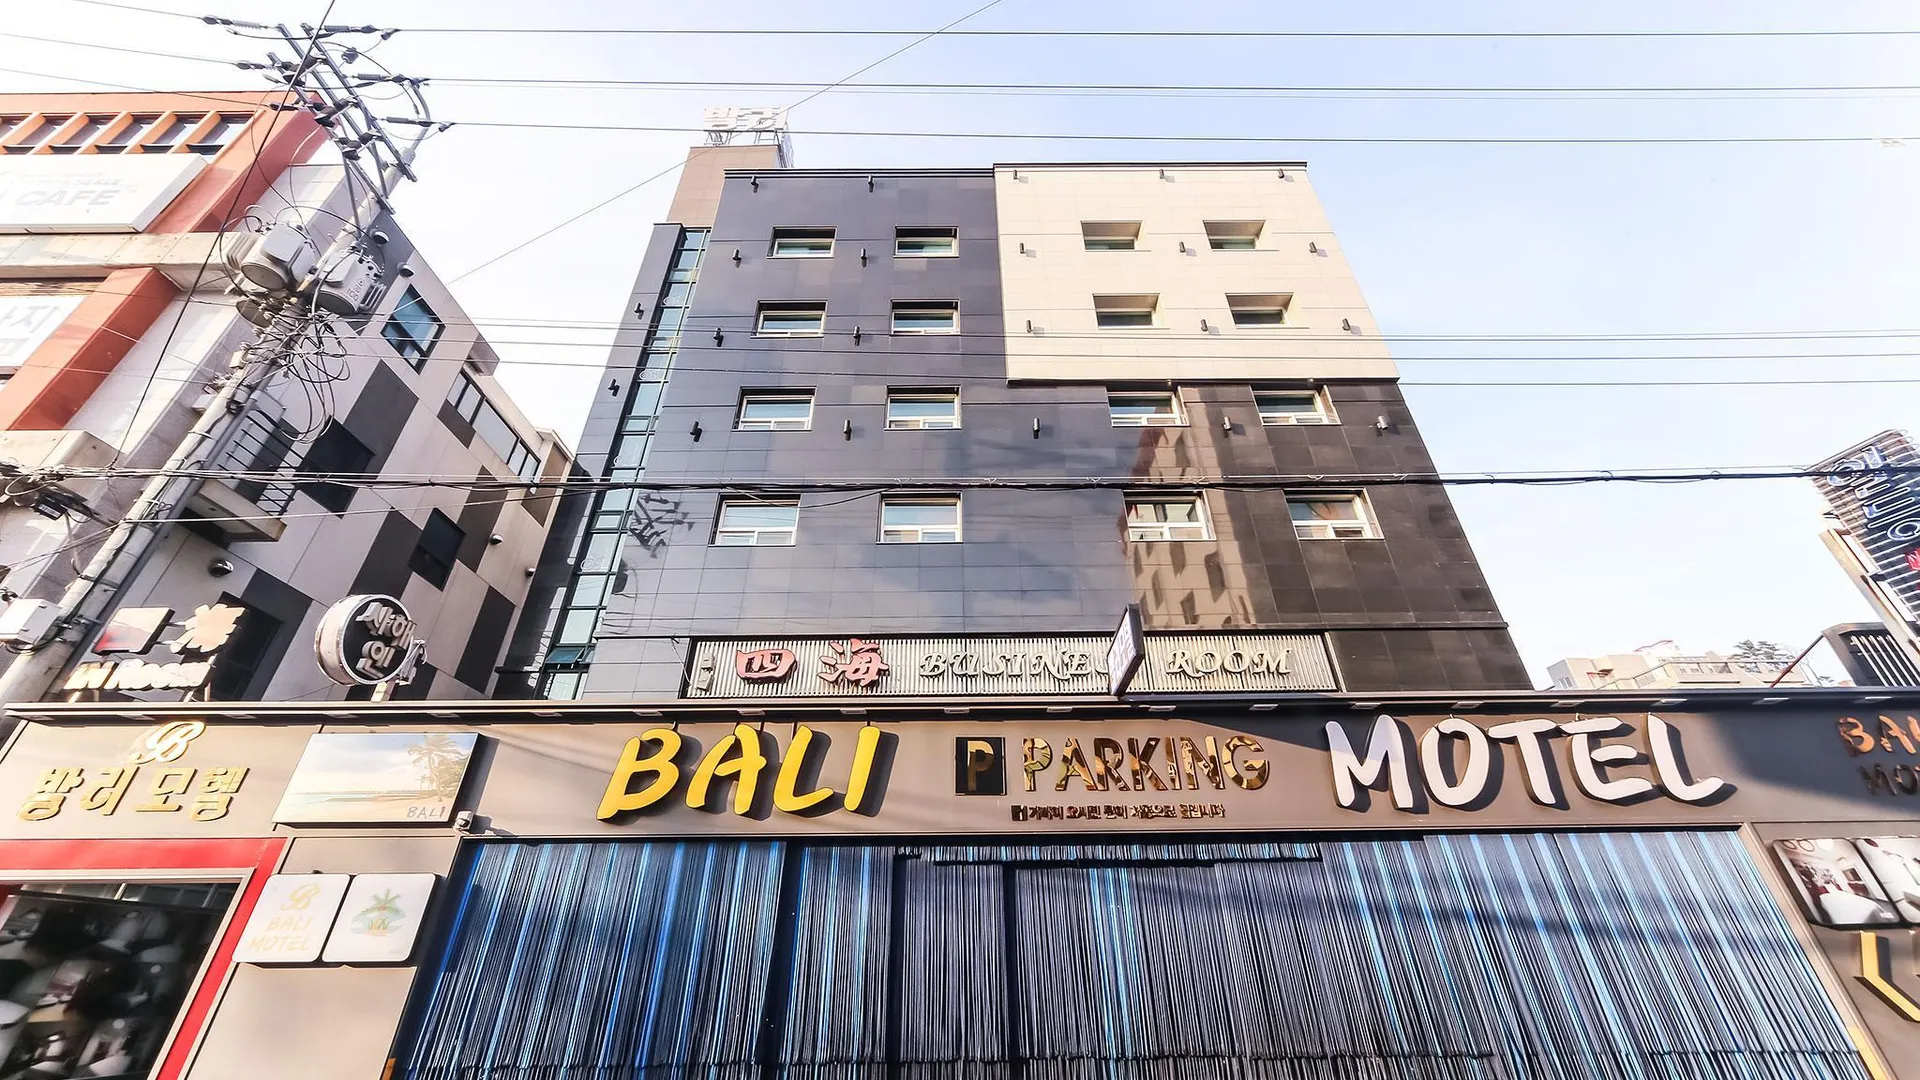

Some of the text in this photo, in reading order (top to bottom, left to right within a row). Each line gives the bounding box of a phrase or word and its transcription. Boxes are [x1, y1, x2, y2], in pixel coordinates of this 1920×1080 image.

[14, 190, 120, 206] CAFE
[1166, 648, 1291, 679] ROOM
[596, 723, 882, 820] BALI
[1022, 735, 1270, 792] PARKING
[1324, 713, 1725, 808] MOTEL
[406, 805, 446, 819] BALI
[265, 916, 313, 932] BALI
[248, 935, 312, 951] MOTEL
